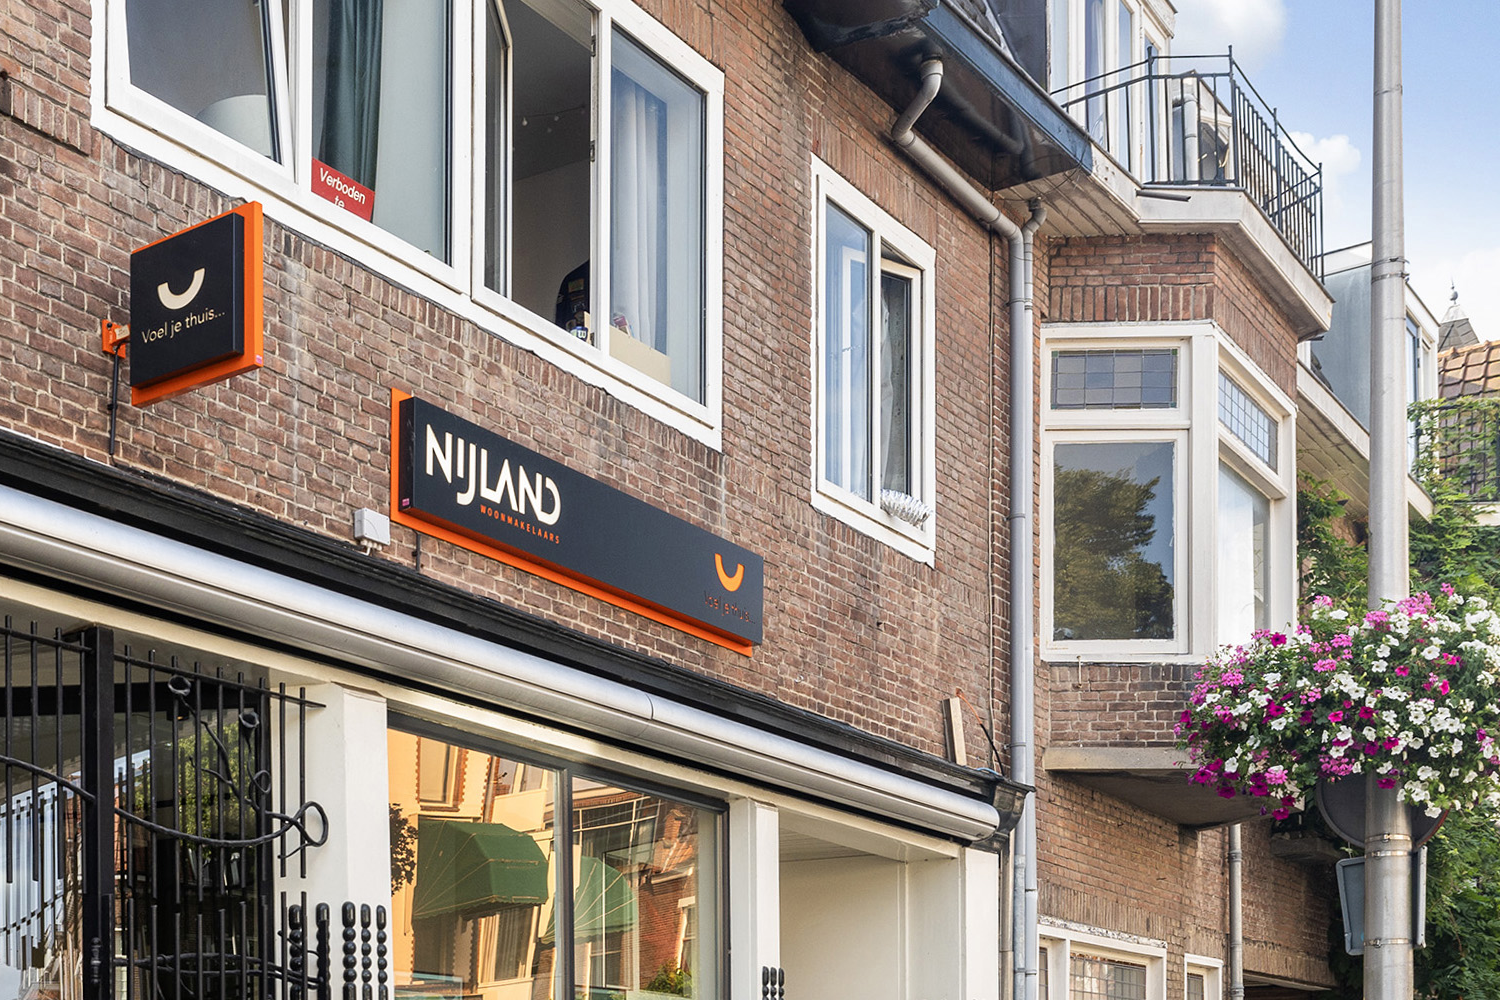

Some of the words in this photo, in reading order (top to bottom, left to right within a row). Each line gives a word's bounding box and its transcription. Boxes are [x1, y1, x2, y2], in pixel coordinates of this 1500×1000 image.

[319, 167, 366, 205] Verboden
[141, 321, 168, 344] Voel
[170, 320, 182, 339] je
[425, 423, 562, 526] NIJLAND
[479, 503, 561, 545] WOONMAKELAARS
